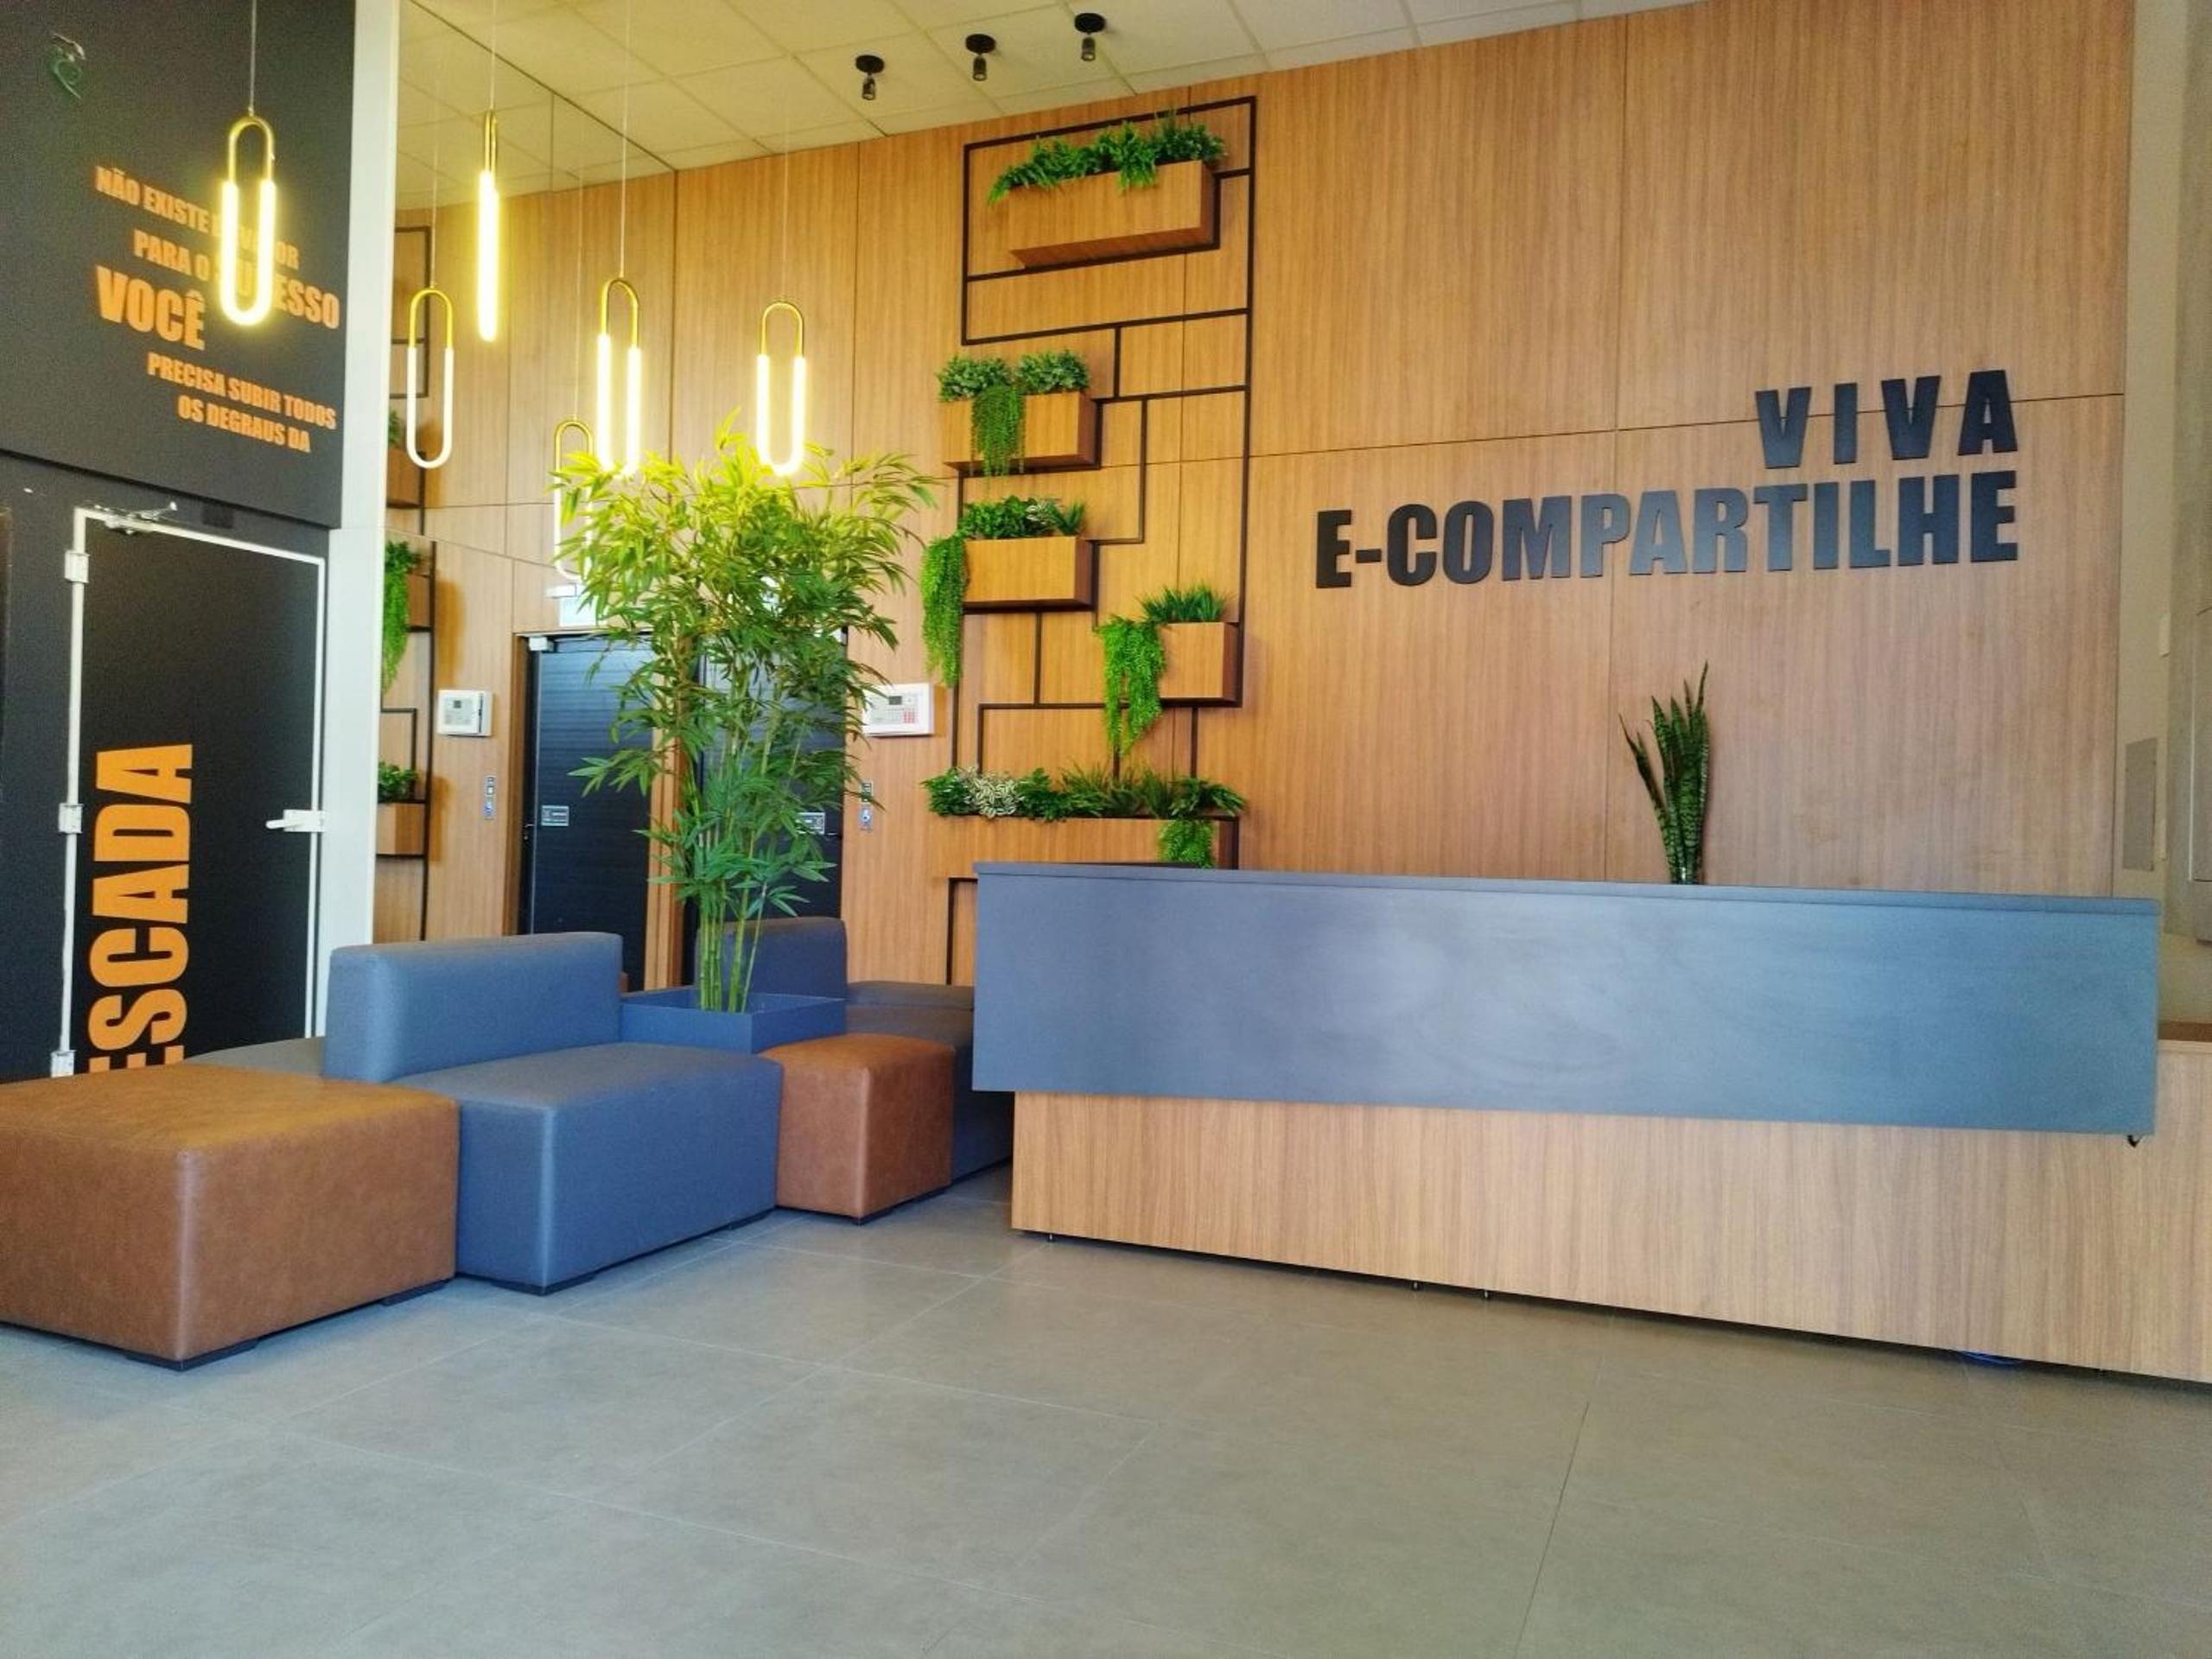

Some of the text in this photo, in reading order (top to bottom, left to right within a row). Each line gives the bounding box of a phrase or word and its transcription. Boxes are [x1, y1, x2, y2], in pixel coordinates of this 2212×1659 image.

[95, 166, 141, 206] NÃO
[143, 185, 209, 234] EXISTE
[134, 229, 192, 276] PARA
[194, 254, 210, 282] O
[96, 265, 205, 350] VOCÊ
[147, 352, 336, 429] PRECISA SUBIR TODOS
[178, 395, 311, 453] OS DEGRAUS DA
[1755, 369, 2018, 469] VIVA
[1315, 471, 2018, 589] E-COMPARTILHE
